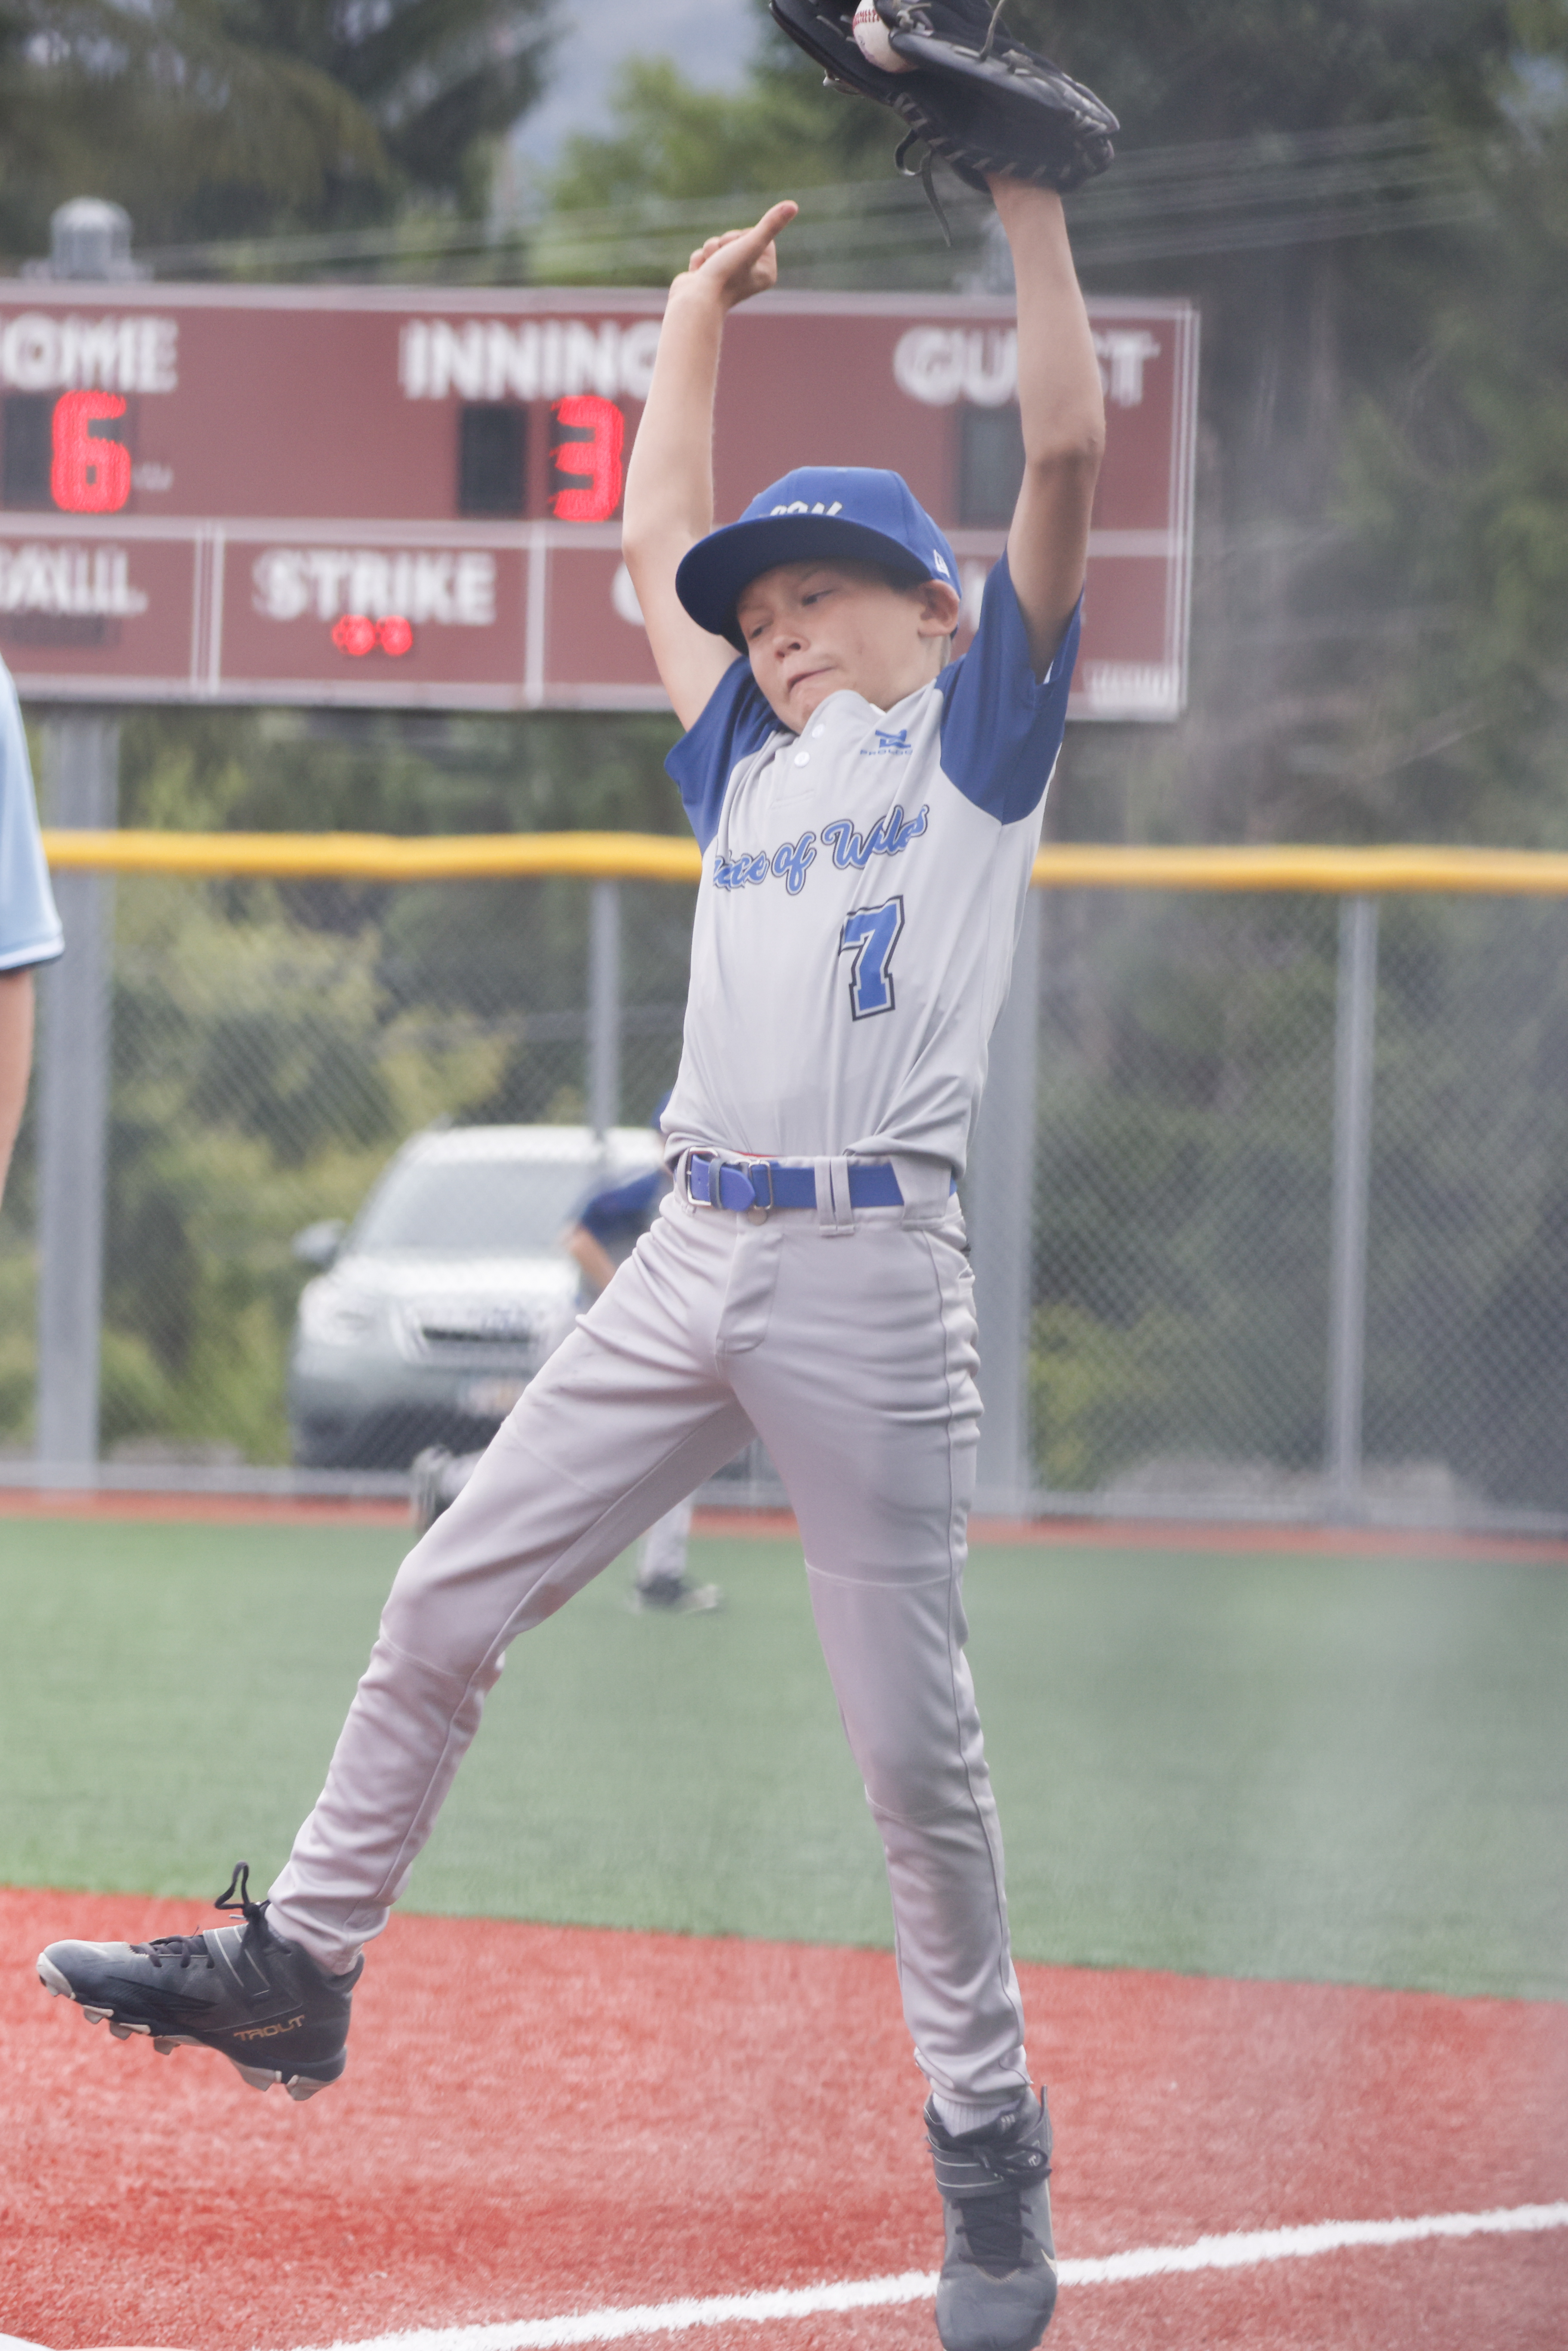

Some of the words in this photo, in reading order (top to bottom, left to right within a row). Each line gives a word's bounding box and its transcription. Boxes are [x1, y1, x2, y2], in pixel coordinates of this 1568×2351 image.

[0, 313, 179, 392] OME
[51, 389, 131, 512] 6
[549, 395, 624, 522] 3
[0, 544, 148, 616] ALL
[252, 549, 497, 626] STRIKE
[772, 831, 817, 895] of
[838, 894, 905, 1021] 7
[233, 2014, 306, 2041] TROUT
